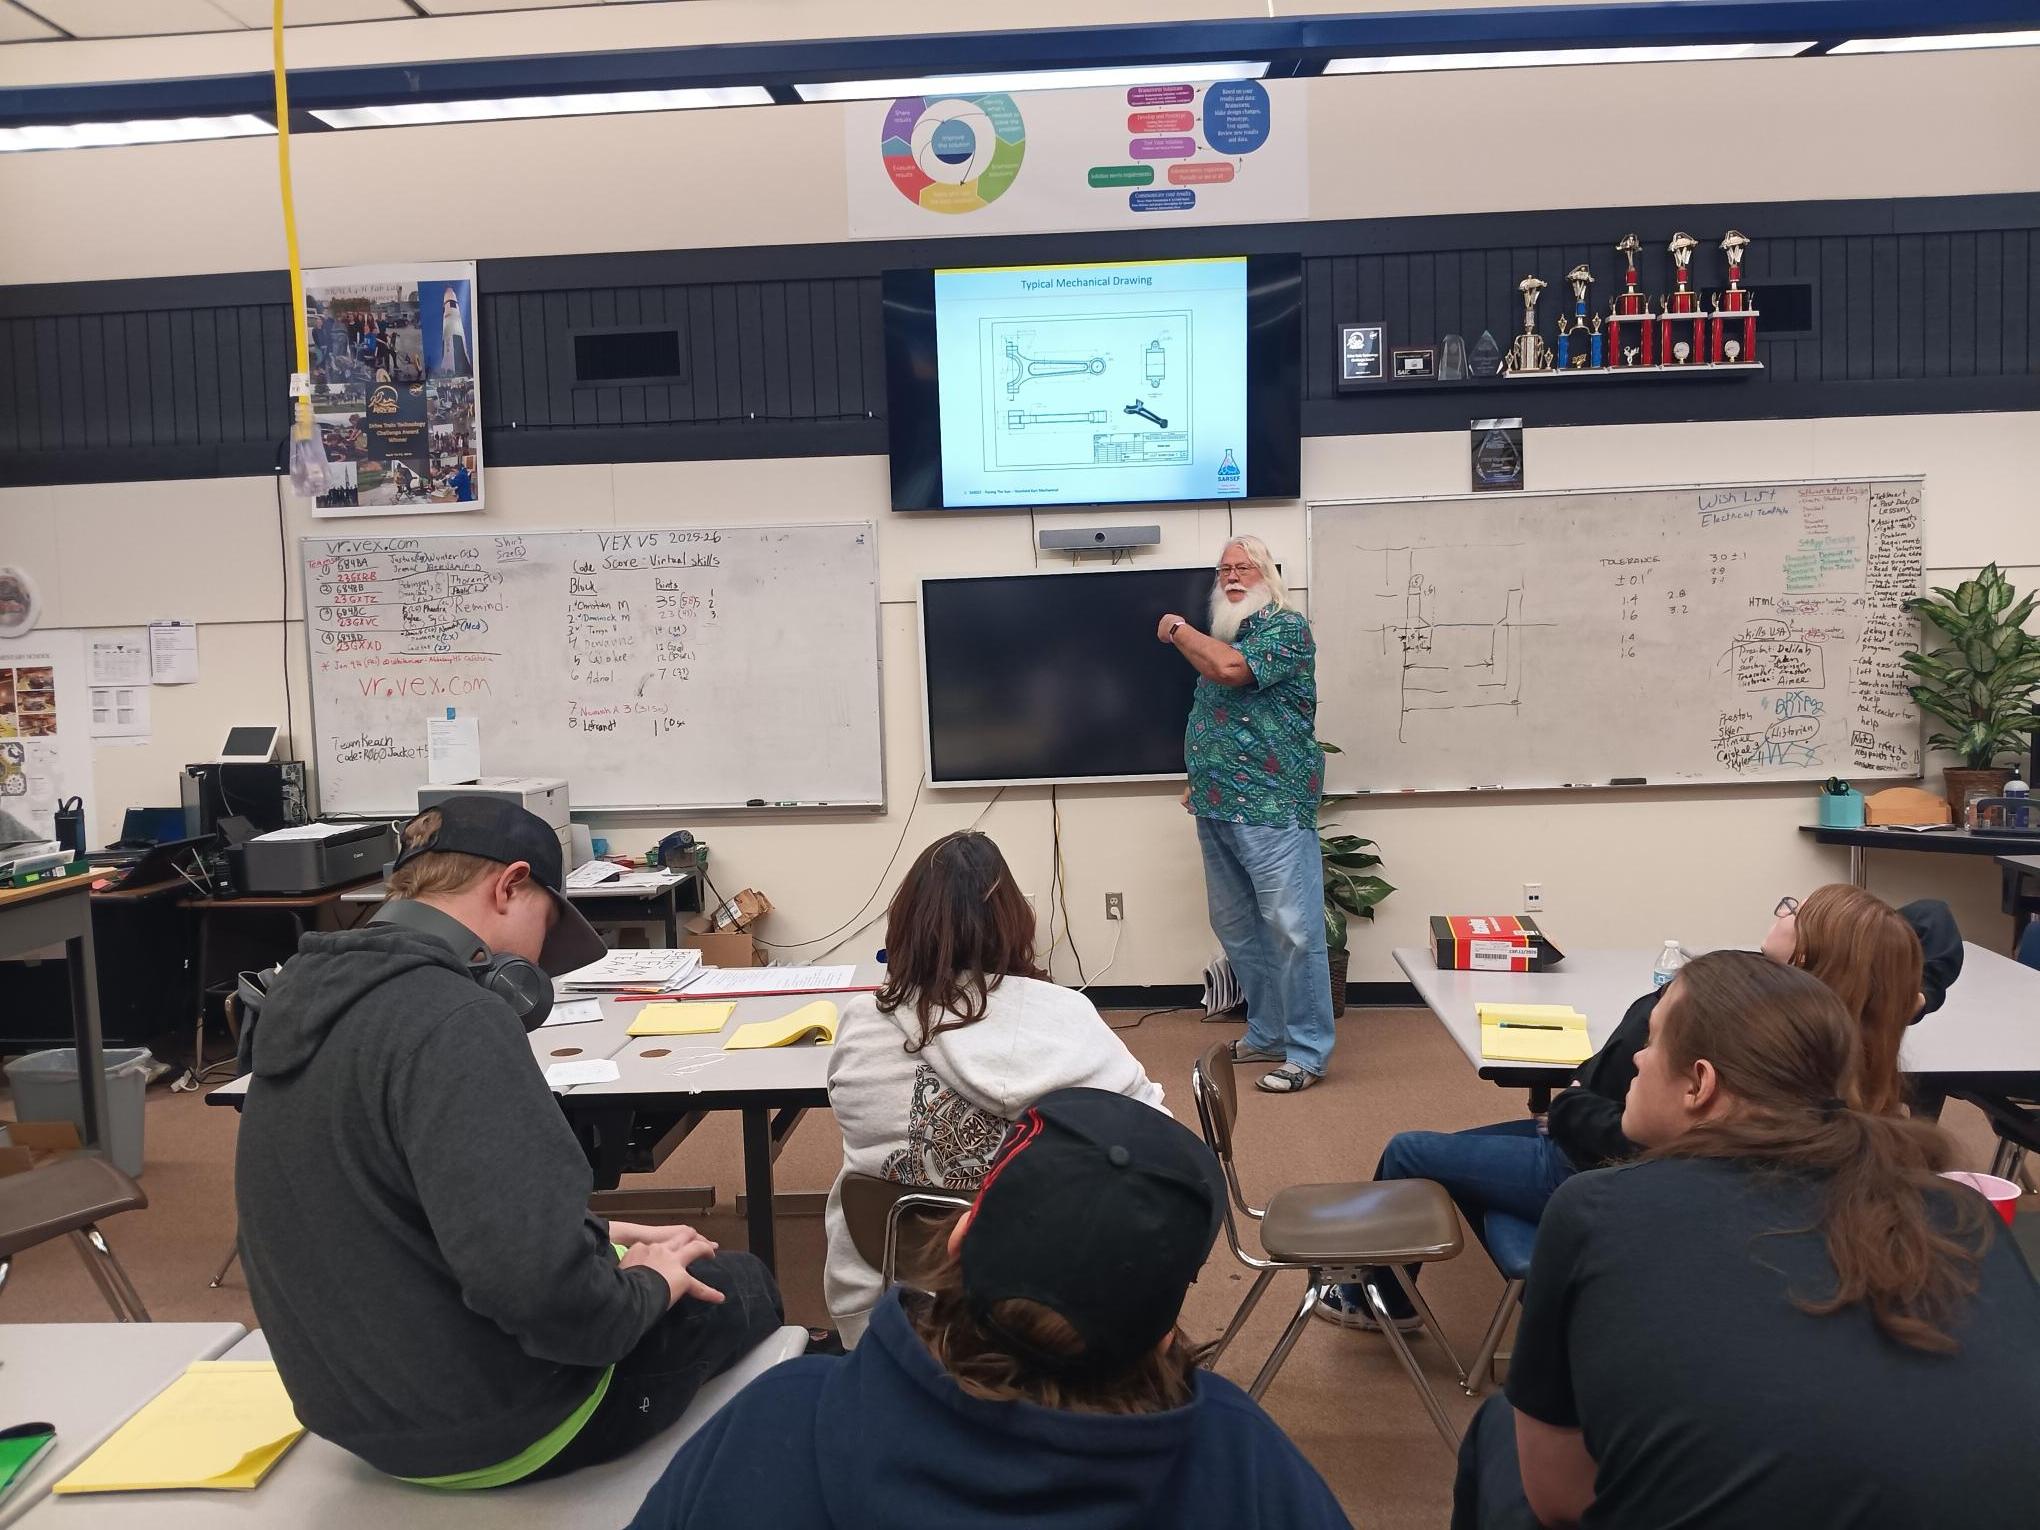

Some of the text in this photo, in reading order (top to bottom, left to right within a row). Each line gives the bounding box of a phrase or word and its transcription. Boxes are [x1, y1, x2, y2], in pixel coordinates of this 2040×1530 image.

[1020, 275, 1153, 291] Typical Mechanical Drawing
[1698, 492, 1737, 511] Wish
[598, 530, 722, 552] VEX V5 2025-26
[602, 554, 639, 570] Score
[650, 552, 686, 566] Virtual
[1600, 555, 1661, 567] TOLERANCE
[656, 595, 677, 609] 35
[1769, 626, 1787, 637] USA
[1777, 643, 1812, 656] Delilah
[658, 667, 667, 680] 7
[358, 676, 493, 698] vr.vex.com
[1860, 715, 1880, 732] help
